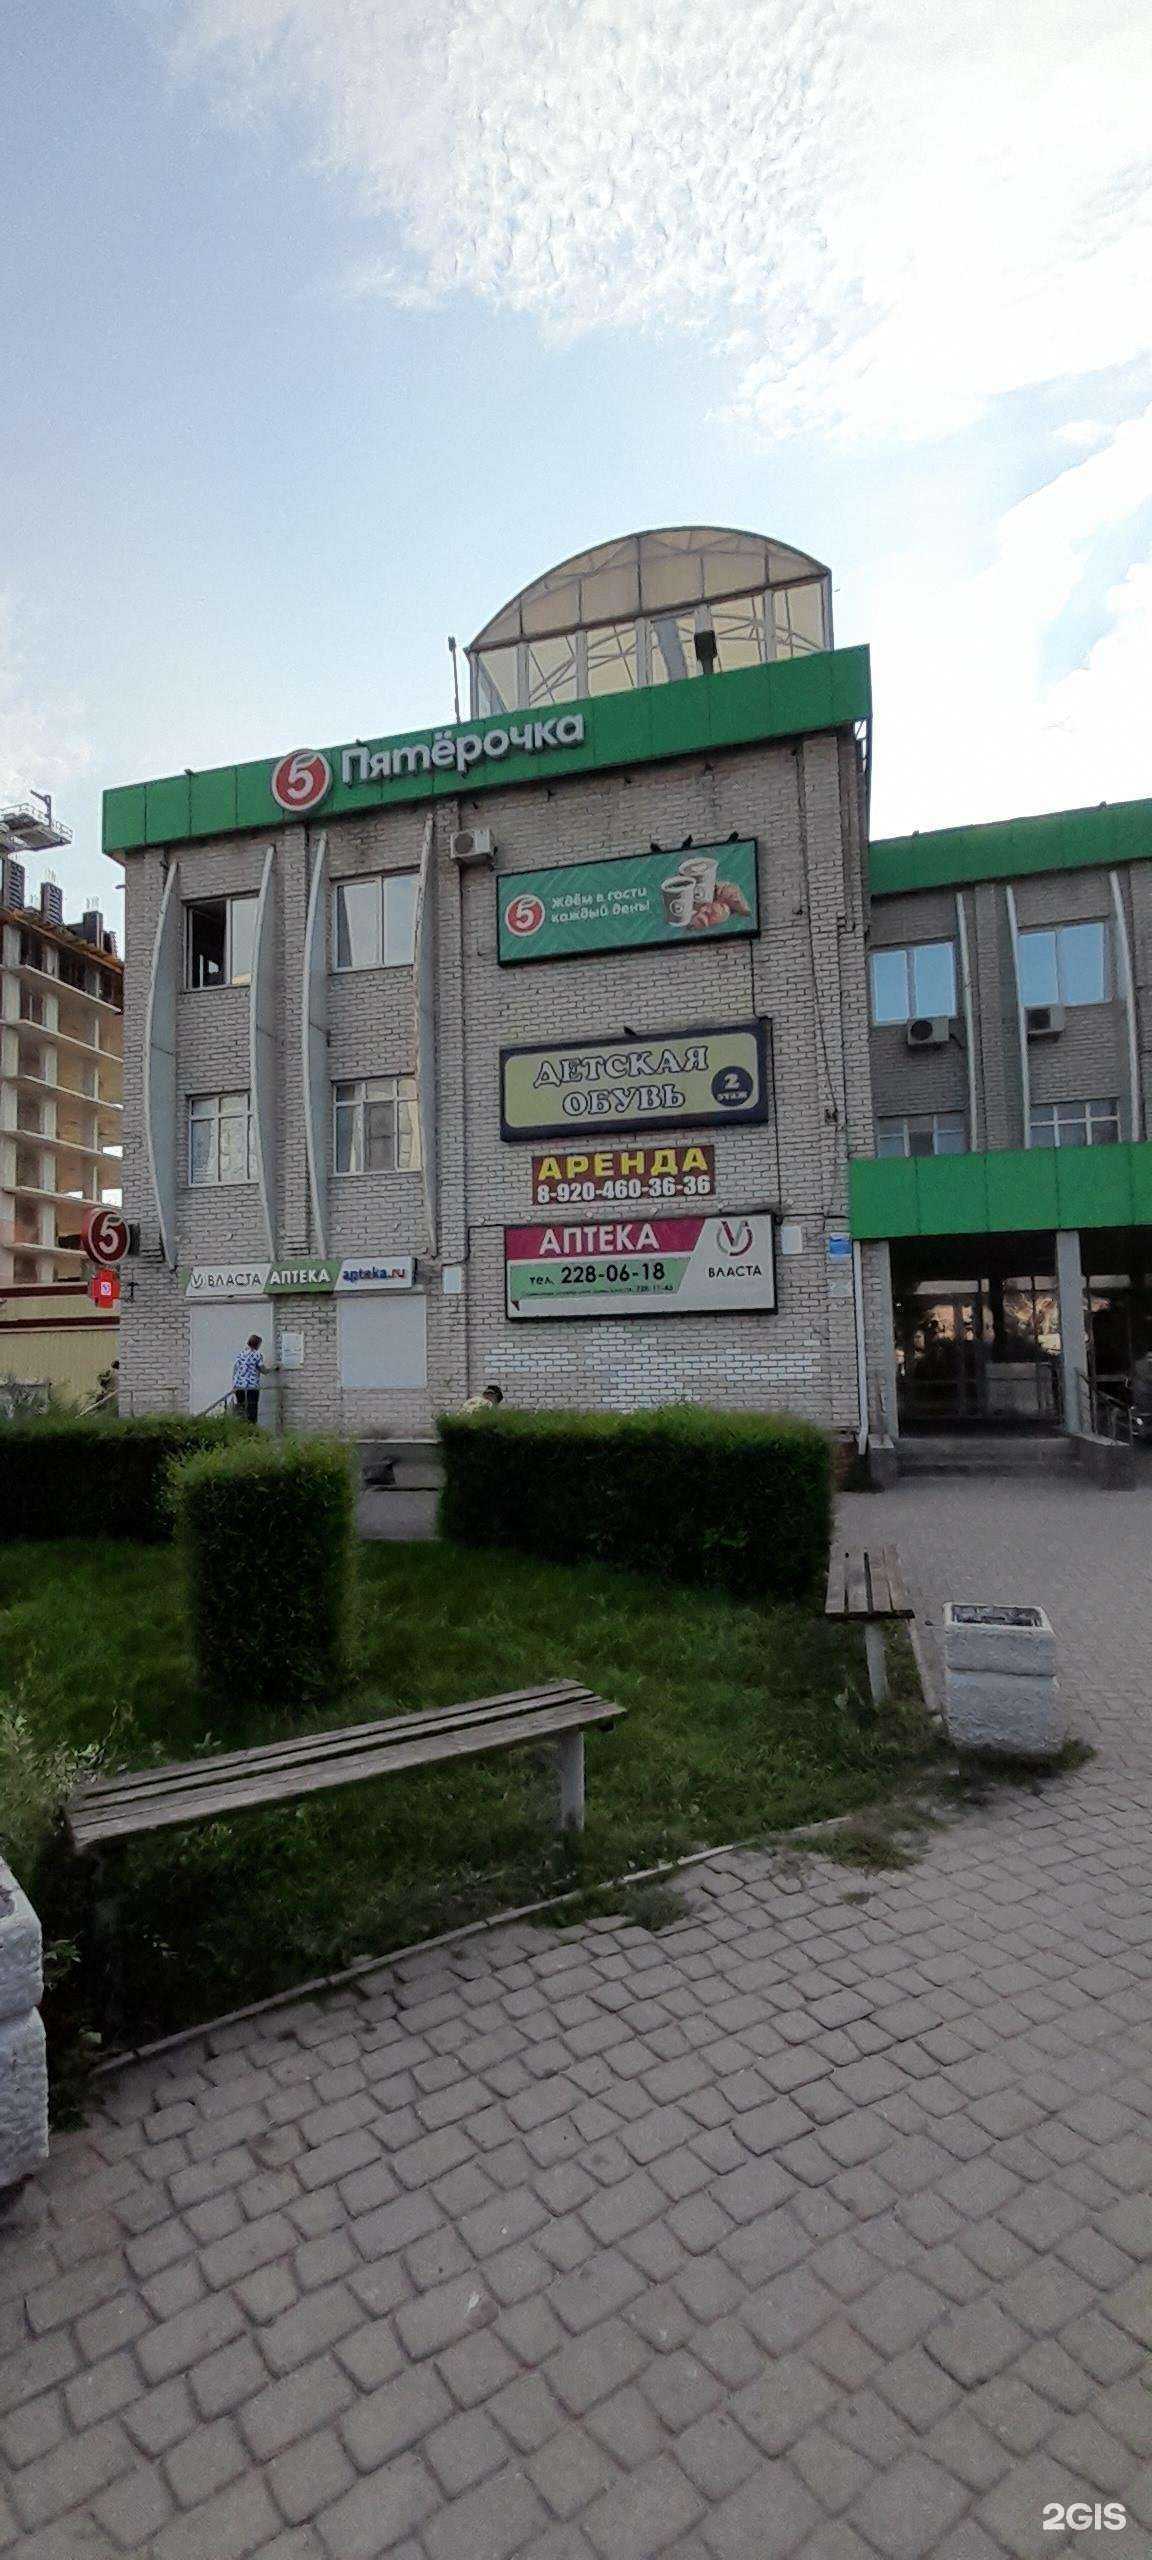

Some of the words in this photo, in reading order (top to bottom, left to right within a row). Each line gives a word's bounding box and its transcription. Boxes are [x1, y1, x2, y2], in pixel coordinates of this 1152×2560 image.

[341, 714, 585, 785] Пятёрочка
[551, 892, 594, 909] Ждём
[606, 887, 648, 901] гости
[551, 906, 609, 923] каждый
[533, 1045, 709, 1089] ДЕТСКАЯ
[724, 1073, 741, 1089] 2
[562, 1083, 686, 1117] ОБУВЬ
[537, 1147, 709, 1181] АРЕНДА
[536, 1175, 712, 1205] 8-920-460-36-36
[539, 1222, 660, 1255] АПТЕКА
[207, 1272, 262, 1288] ВЛАСТА
[268, 1268, 331, 1286] АПТЕКА
[342, 1266, 406, 1282] apteka.ru
[560, 1262, 666, 1284] 228-06-18
[708, 1265, 763, 1278] ВЛАСТА
